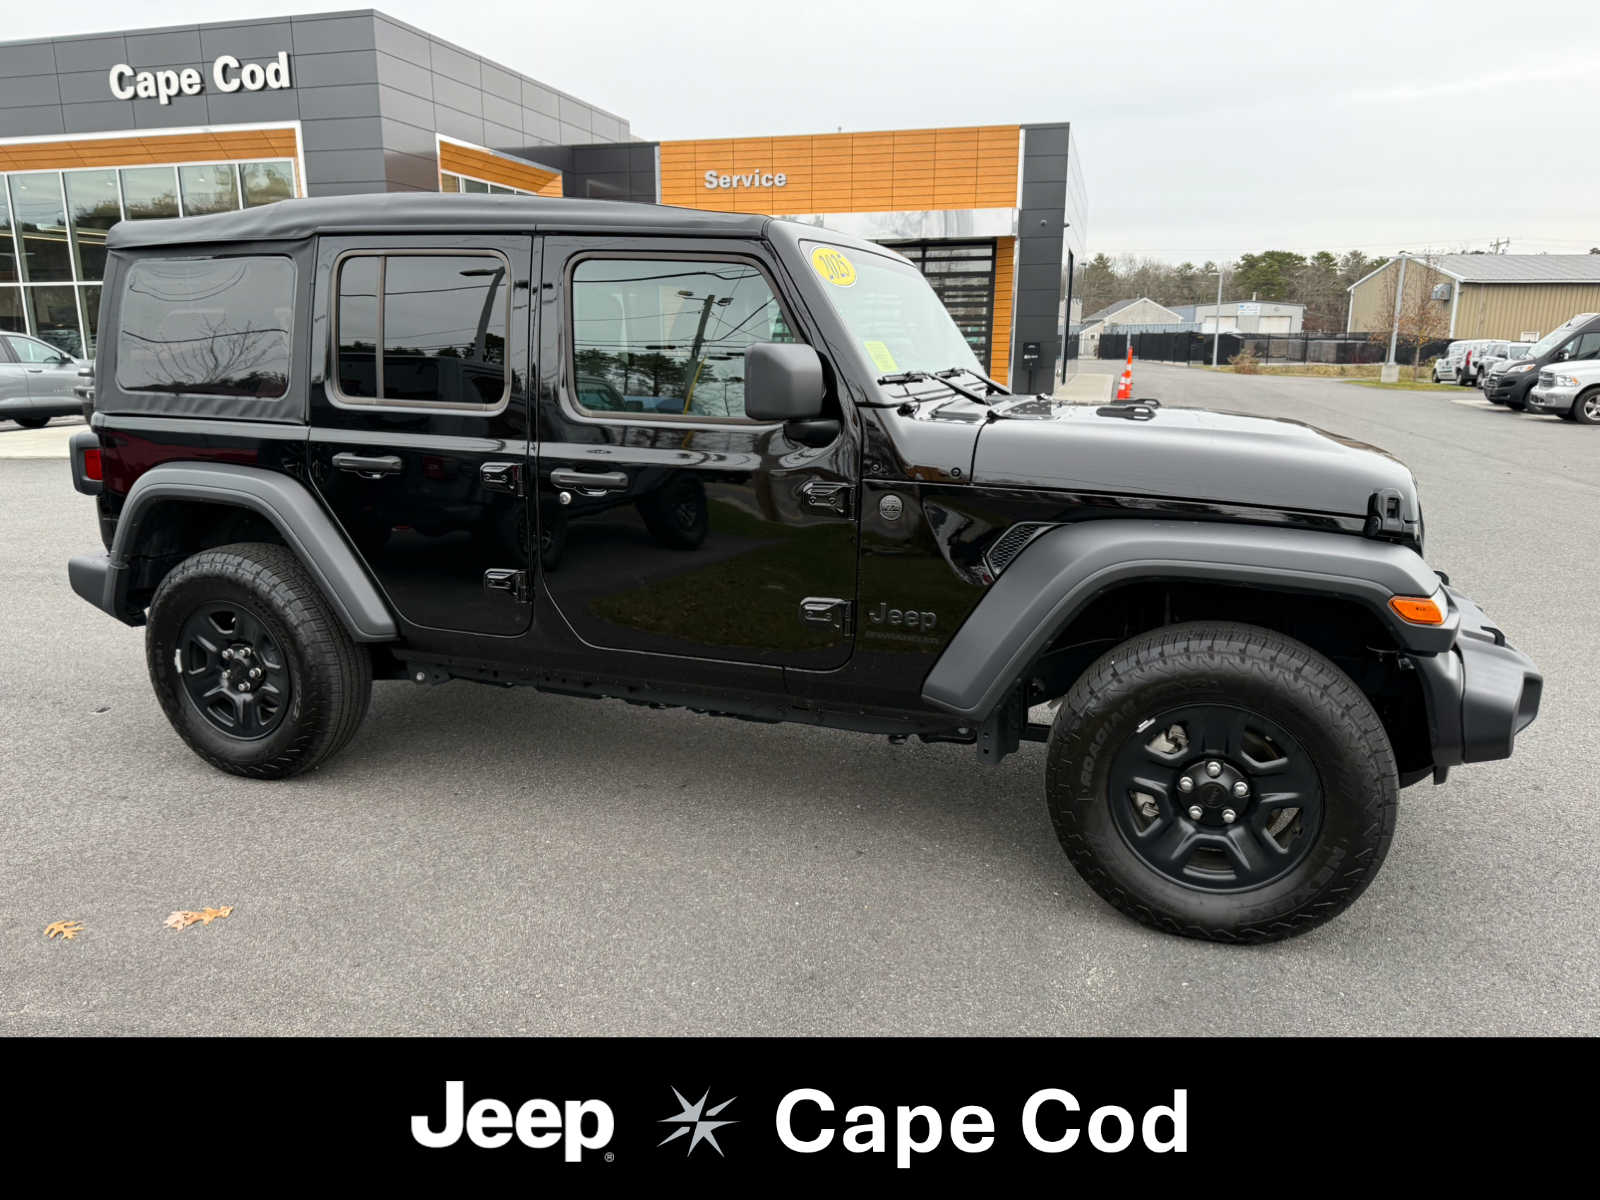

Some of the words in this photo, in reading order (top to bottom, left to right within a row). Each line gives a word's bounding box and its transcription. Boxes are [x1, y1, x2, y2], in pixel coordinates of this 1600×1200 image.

[109, 63, 201, 105] Cape
[212, 50, 290, 93] Cod
[704, 168, 787, 189] Service
[867, 602, 937, 633] Jeep
